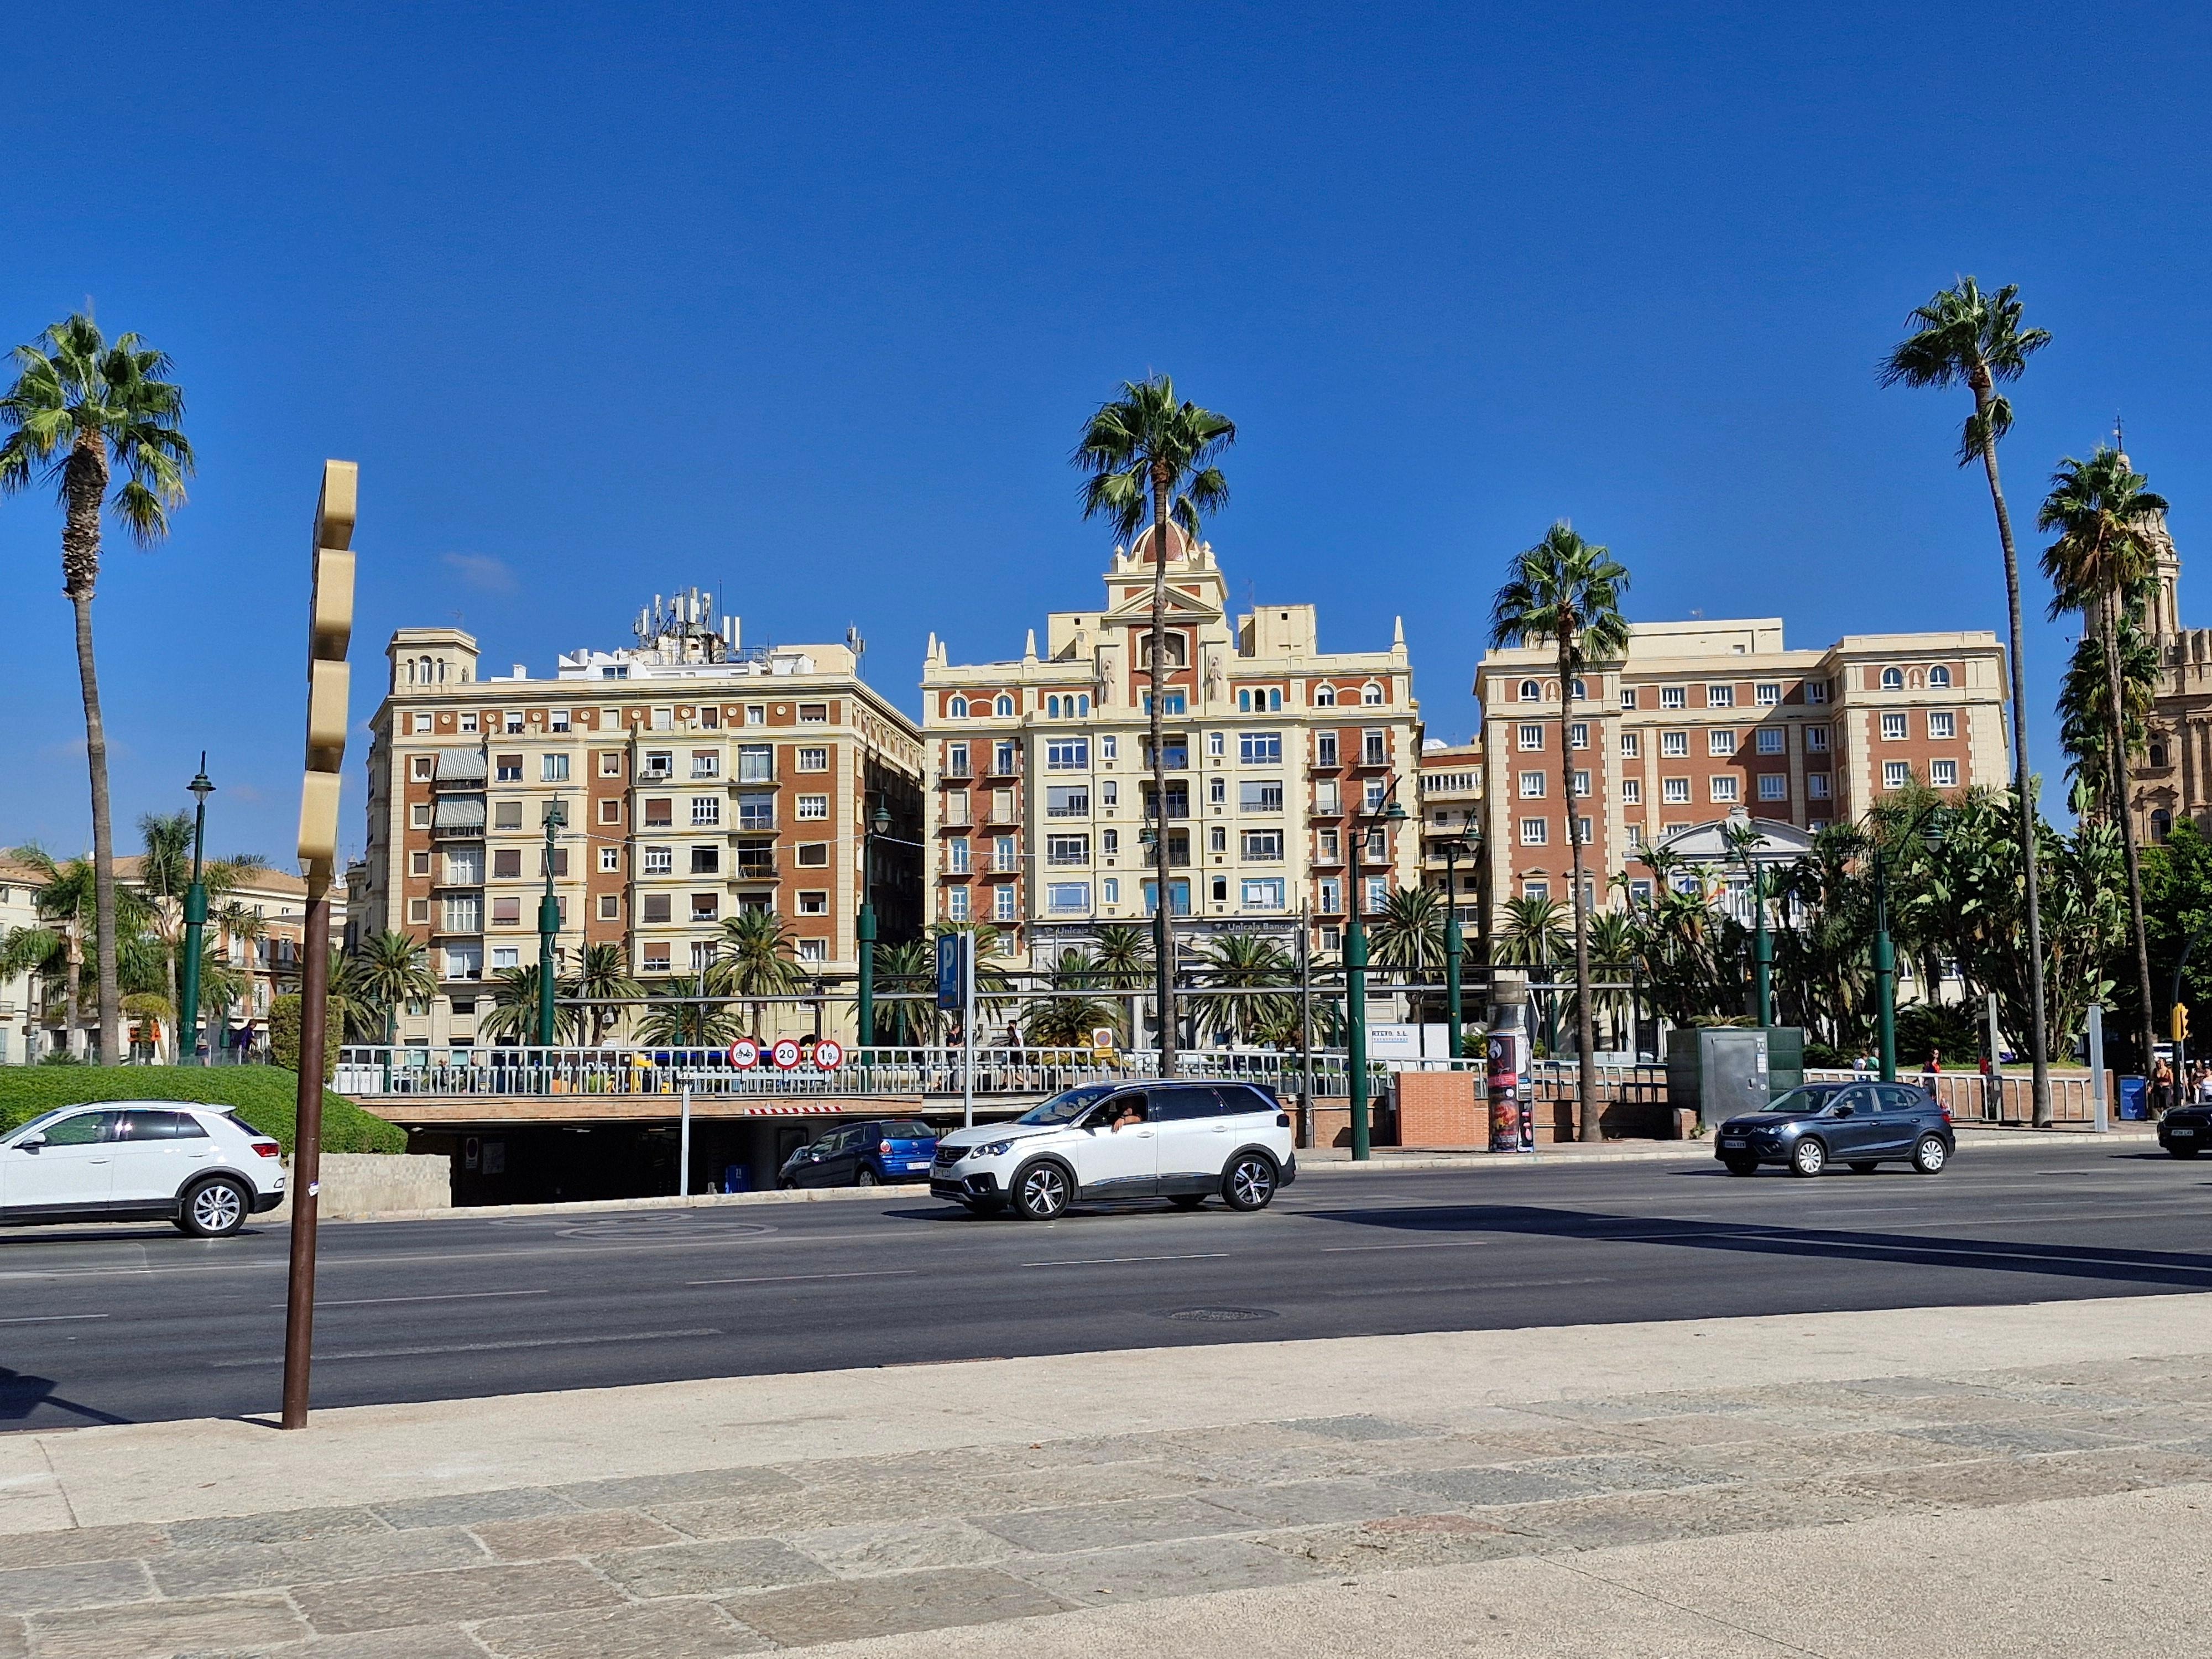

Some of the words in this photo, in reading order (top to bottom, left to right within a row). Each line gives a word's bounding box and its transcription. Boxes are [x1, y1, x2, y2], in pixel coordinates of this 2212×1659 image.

[1227, 922, 1261, 932] Unicaja
[943, 940, 954, 982] P
[779, 1050, 794, 1058] 20
